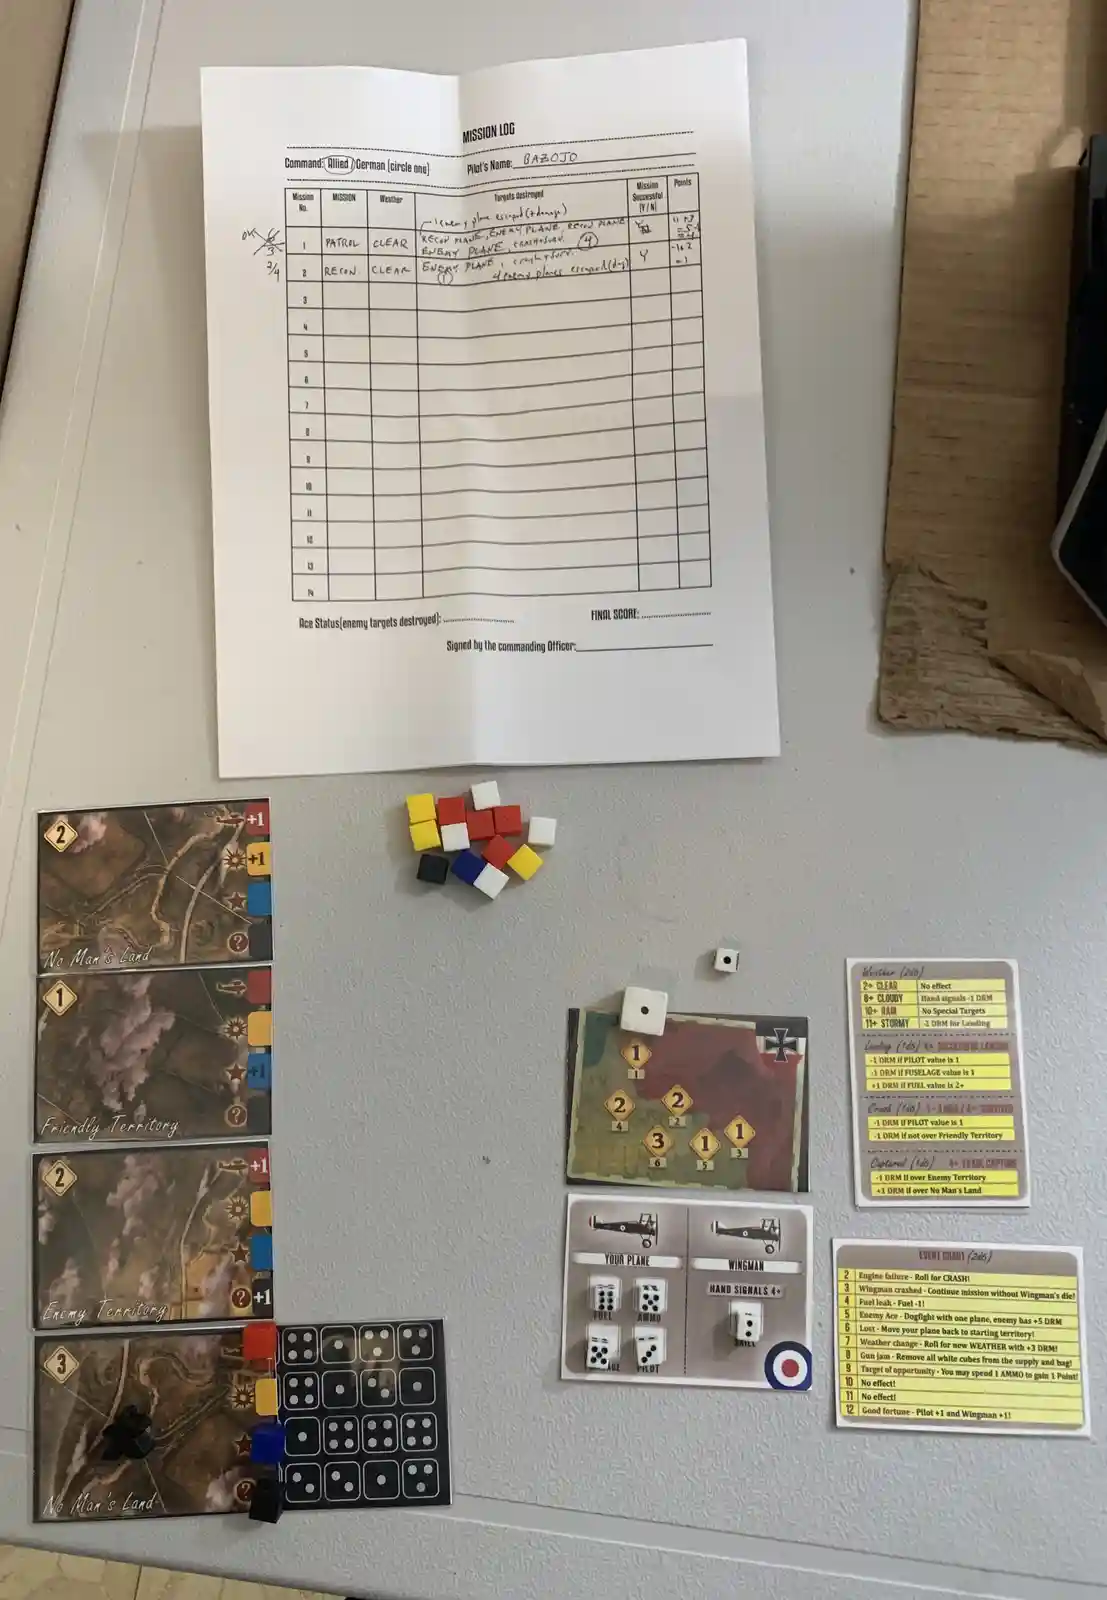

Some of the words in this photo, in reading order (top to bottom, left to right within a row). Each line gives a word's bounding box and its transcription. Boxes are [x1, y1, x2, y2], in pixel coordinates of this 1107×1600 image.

[462, 124, 497, 144] MISSION
[499, 122, 515, 136] LOG
[284, 158, 324, 169] Command:
[327, 158, 349, 169] Allied
[356, 159, 386, 171] German
[523, 151, 578, 165] BAZOJO
[467, 162, 489, 175] Pilot's
[490, 160, 513, 172] Name:
[636, 181, 658, 190] Mission
[674, 178, 692, 188] Points
[332, 193, 356, 202] MISSION
[380, 195, 404, 204] Weather
[494, 191, 516, 202] Targets
[516, 190, 544, 201] destroyed
[632, 192, 664, 202] Successful
[325, 238, 360, 249] PATROL
[373, 238, 409, 250] CLEAR
[640, 248, 648, 262] Y
[324, 266, 356, 277] RECON
[372, 266, 410, 275] CLEAR
[591, 609, 612, 620] FINAL
[613, 608, 640, 620] SCORE:
[299, 618, 314, 628] Ace
[370, 616, 398, 628] targets
[446, 640, 472, 652] Signed
[473, 640, 483, 652] by
[484, 640, 496, 652] the
[498, 642, 546, 654] commanding
[247, 812, 264, 827] +1
[56, 826, 65, 844] 2
[248, 851, 265, 866] +1
[44, 951, 64, 969] No
[120, 946, 153, 962] Land
[56, 988, 63, 1007] 1
[864, 994, 874, 1003] 8+
[877, 994, 903, 1002] CLOUDY
[932, 1008, 958, 1016] Special
[866, 1019, 878, 1028] 11+
[881, 1019, 909, 1028] STORMY
[631, 1044, 640, 1061] 1
[250, 1064, 265, 1079] +1
[614, 1096, 626, 1113] 2
[672, 1091, 684, 1109] 2
[40, 1117, 100, 1140] Friendly
[107, 1114, 180, 1136] Territory
[735, 1123, 744, 1140] 1
[651, 1132, 664, 1149] 3
[701, 1135, 709, 1152] 1
[250, 1157, 268, 1174] +1
[55, 1168, 64, 1188] 2
[604, 1253, 625, 1267] YOUR
[626, 1255, 650, 1267] PLANE
[728, 1260, 765, 1272] WINGMAN
[844, 1270, 849, 1279] 2
[942, 1274, 970, 1282] CRASH!
[253, 1288, 271, 1305] +1
[709, 1284, 732, 1294] HAND
[735, 1285, 769, 1296] SIGNALS
[771, 1286, 781, 1296] 4+
[844, 1283, 849, 1292] 3
[859, 1285, 893, 1293] Wingman
[1020, 1291, 1060, 1300] Wingman's
[844, 1296, 849, 1305] 4
[43, 1301, 87, 1326] Enemy
[96, 1298, 169, 1322] Territory
[637, 1313, 661, 1322] AMMO
[845, 1310, 849, 1318] 5
[859, 1311, 884, 1320] Enemy
[904, 1313, 934, 1322] Dogfight
[970, 1315, 992, 1324] plane,
[845, 1323, 850, 1332] 6
[920, 1327, 940, 1335] plane
[970, 1329, 998, 1338] starting
[1000, 1330, 1034, 1340] territory!
[845, 1336, 850, 1345] 7
[893, 1340, 918, 1348] change
[57, 1353, 67, 1374] 3
[846, 1350, 850, 1359] 8
[1015, 1358, 1039, 1366] supply
[846, 1377, 853, 1386] 10
[846, 1391, 853, 1400] 11
[846, 1405, 854, 1414] 12
[962, 1411, 997, 1420] Wingman
[43, 1496, 63, 1514] No
[121, 1492, 158, 1511] Land
